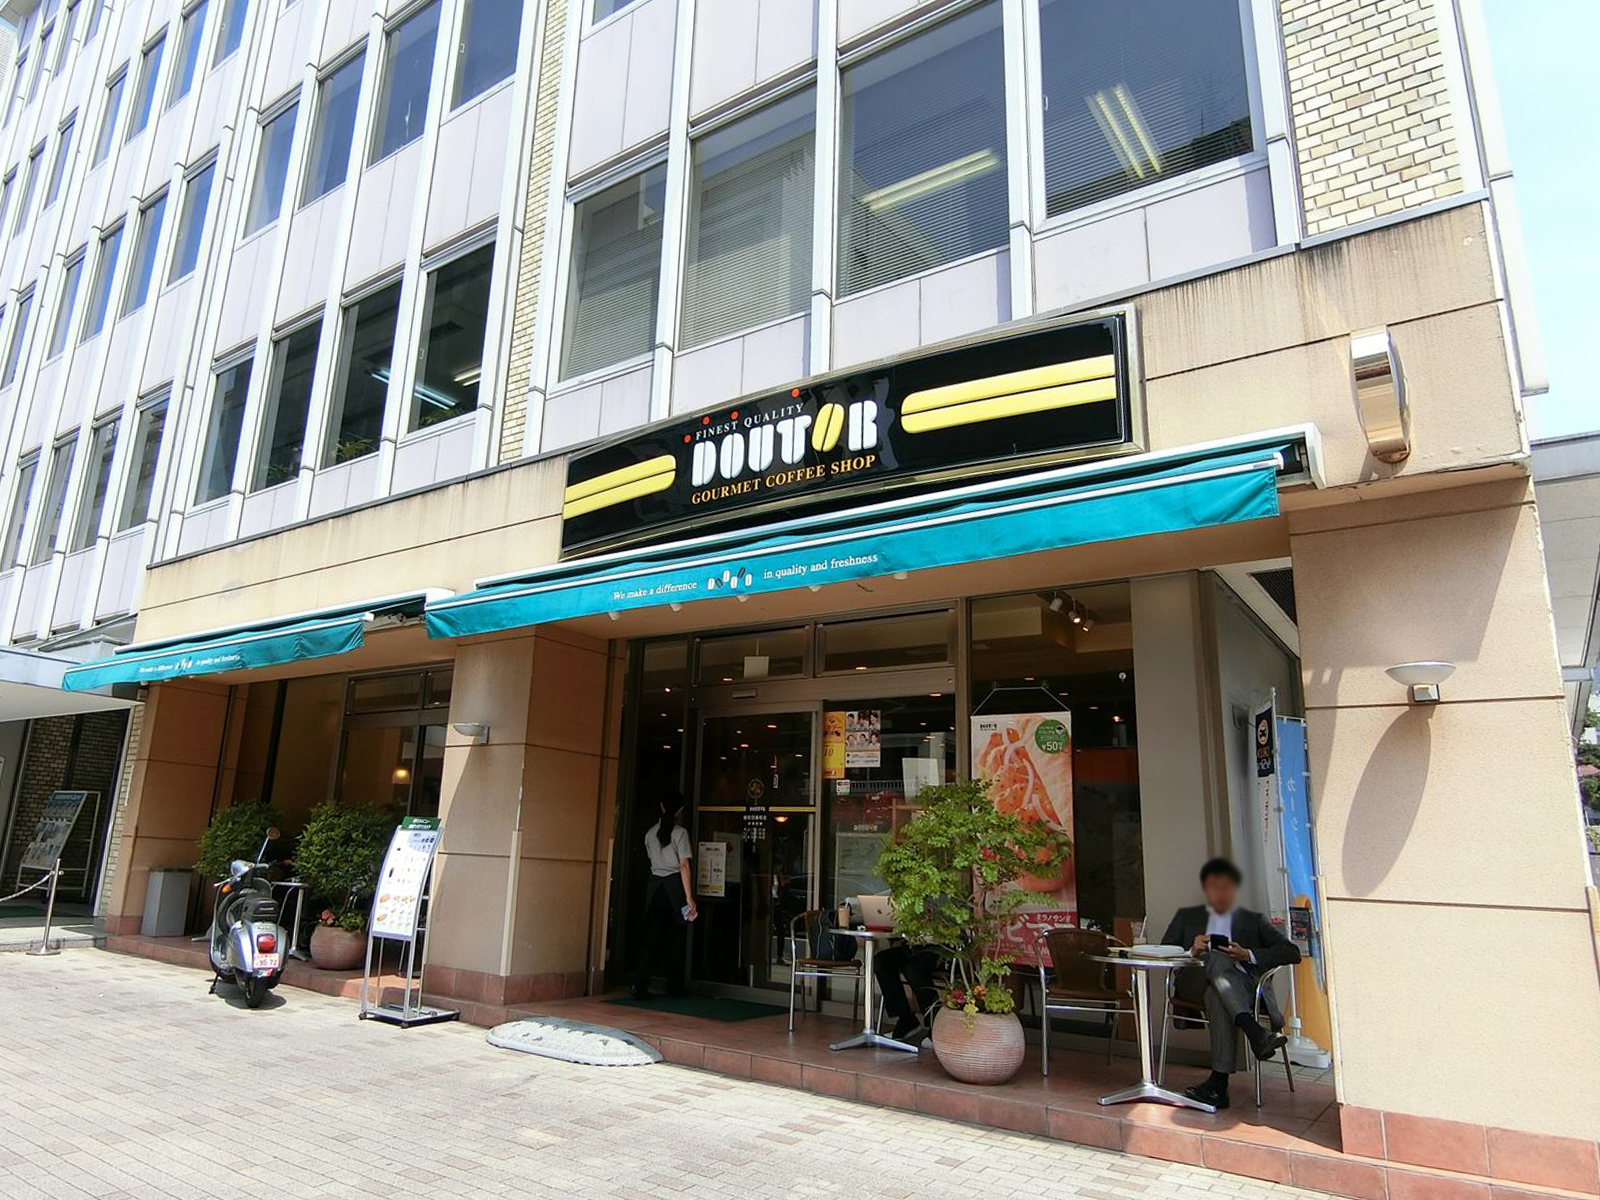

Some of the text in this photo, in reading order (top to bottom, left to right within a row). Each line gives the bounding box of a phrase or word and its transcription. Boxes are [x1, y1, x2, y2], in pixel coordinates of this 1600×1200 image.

[691, 400, 878, 487] DOUTOR
[695, 402, 804, 441] FINEST QUALITY
[691, 455, 876, 505] GOURMET COFFEE SHOP
[613, 591, 626, 600] We
[626, 588, 648, 599] make
[655, 581, 698, 595] difference
[763, 569, 773, 579] in
[775, 564, 808, 579] quality
[810, 560, 828, 572] and
[830, 554, 879, 569] freshness
